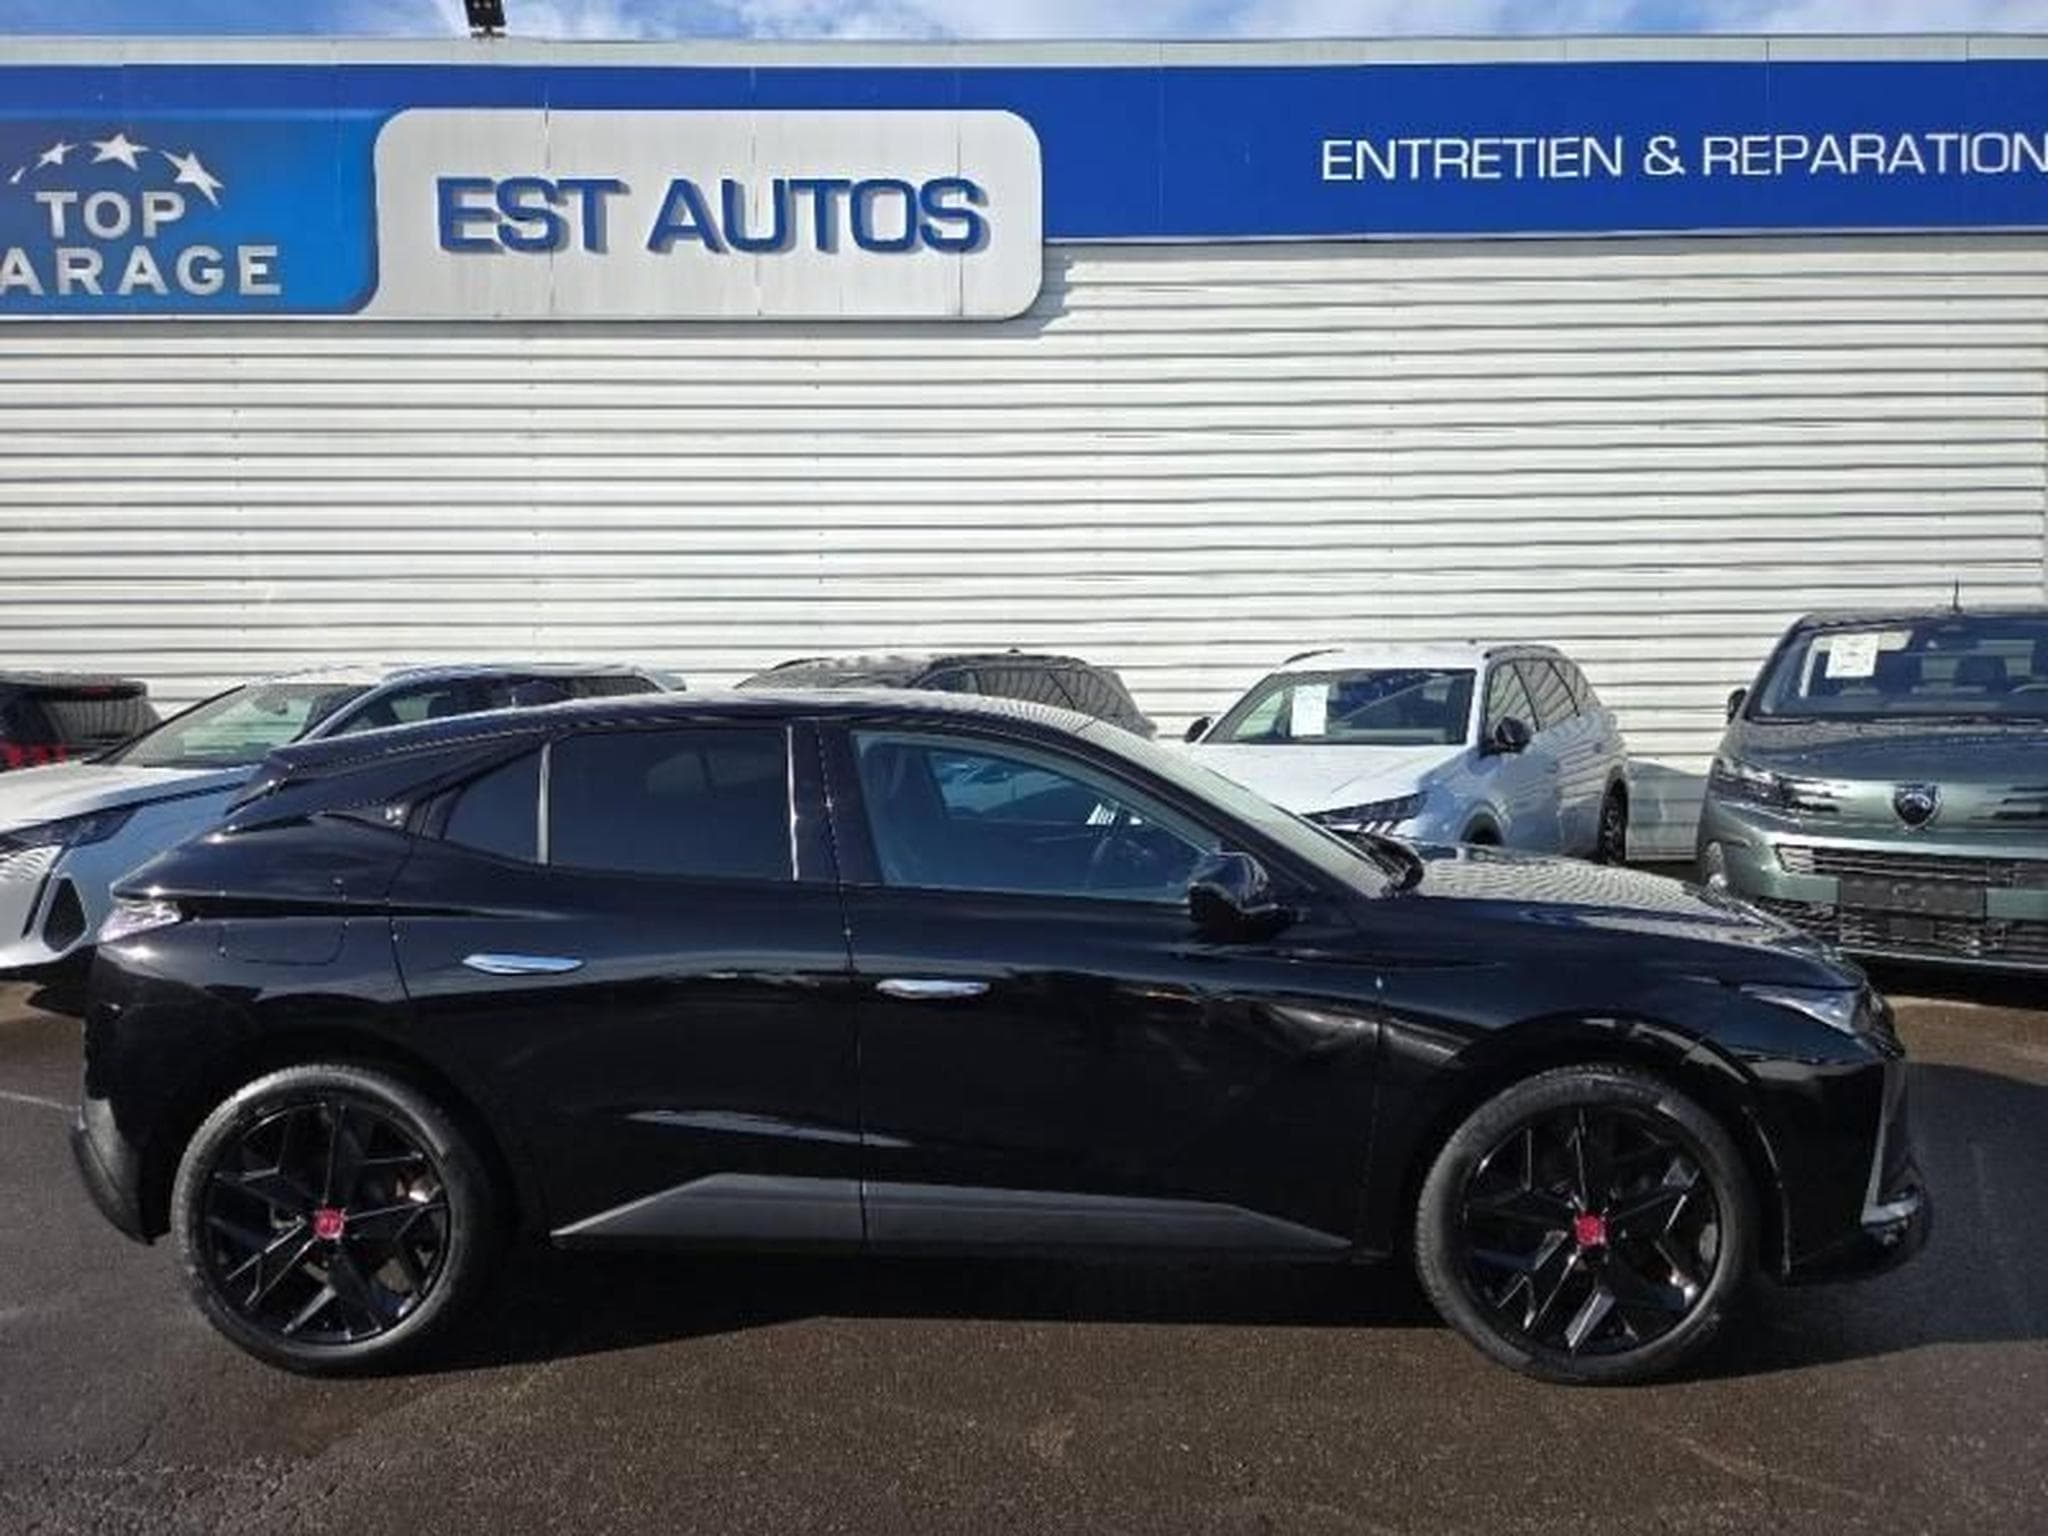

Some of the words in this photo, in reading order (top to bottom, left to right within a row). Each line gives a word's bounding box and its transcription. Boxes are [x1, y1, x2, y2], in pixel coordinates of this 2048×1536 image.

[1321, 135, 1623, 181] ENTRETIEN
[1643, 134, 1686, 176] &
[1702, 132, 2048, 177] REPARATION
[35, 190, 186, 239] TOP
[436, 176, 627, 252] EST
[646, 176, 990, 253] AUTOS
